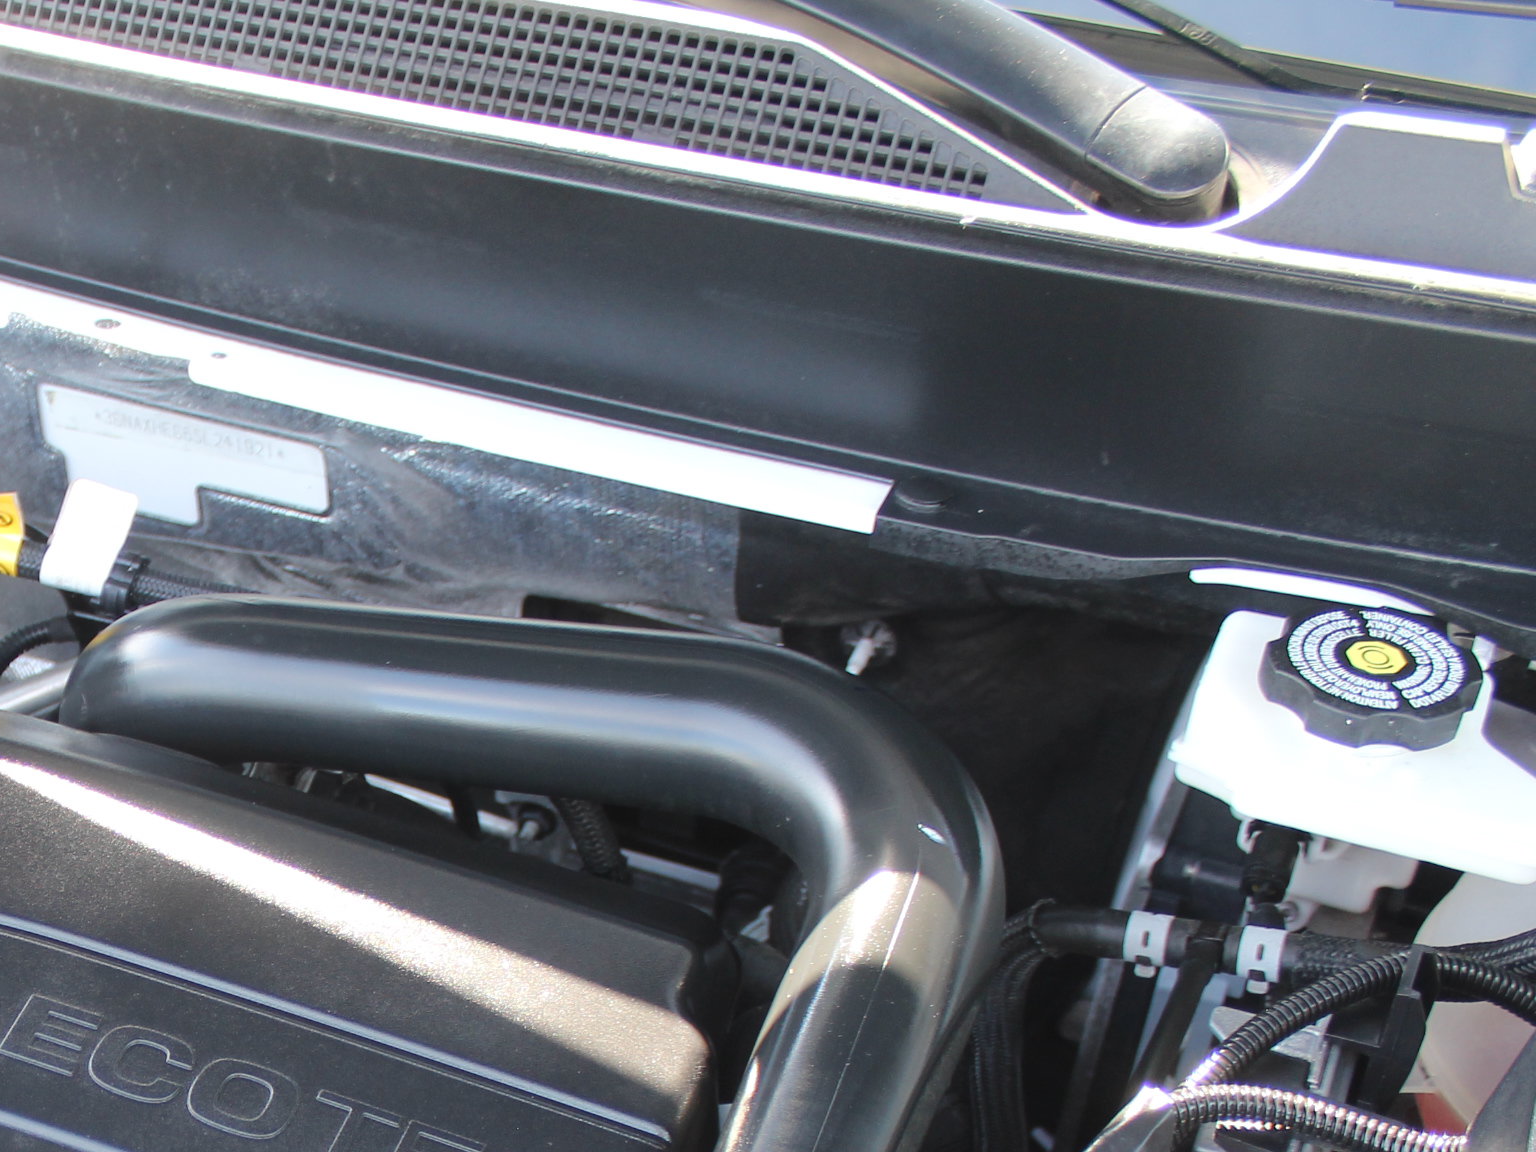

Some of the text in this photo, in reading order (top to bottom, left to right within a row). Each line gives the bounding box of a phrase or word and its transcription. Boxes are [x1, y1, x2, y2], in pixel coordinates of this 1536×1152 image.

[1362, 618, 1397, 632] ONLY
[1365, 628, 1409, 645] FILLER
[1421, 630, 1460, 657] SEALED
